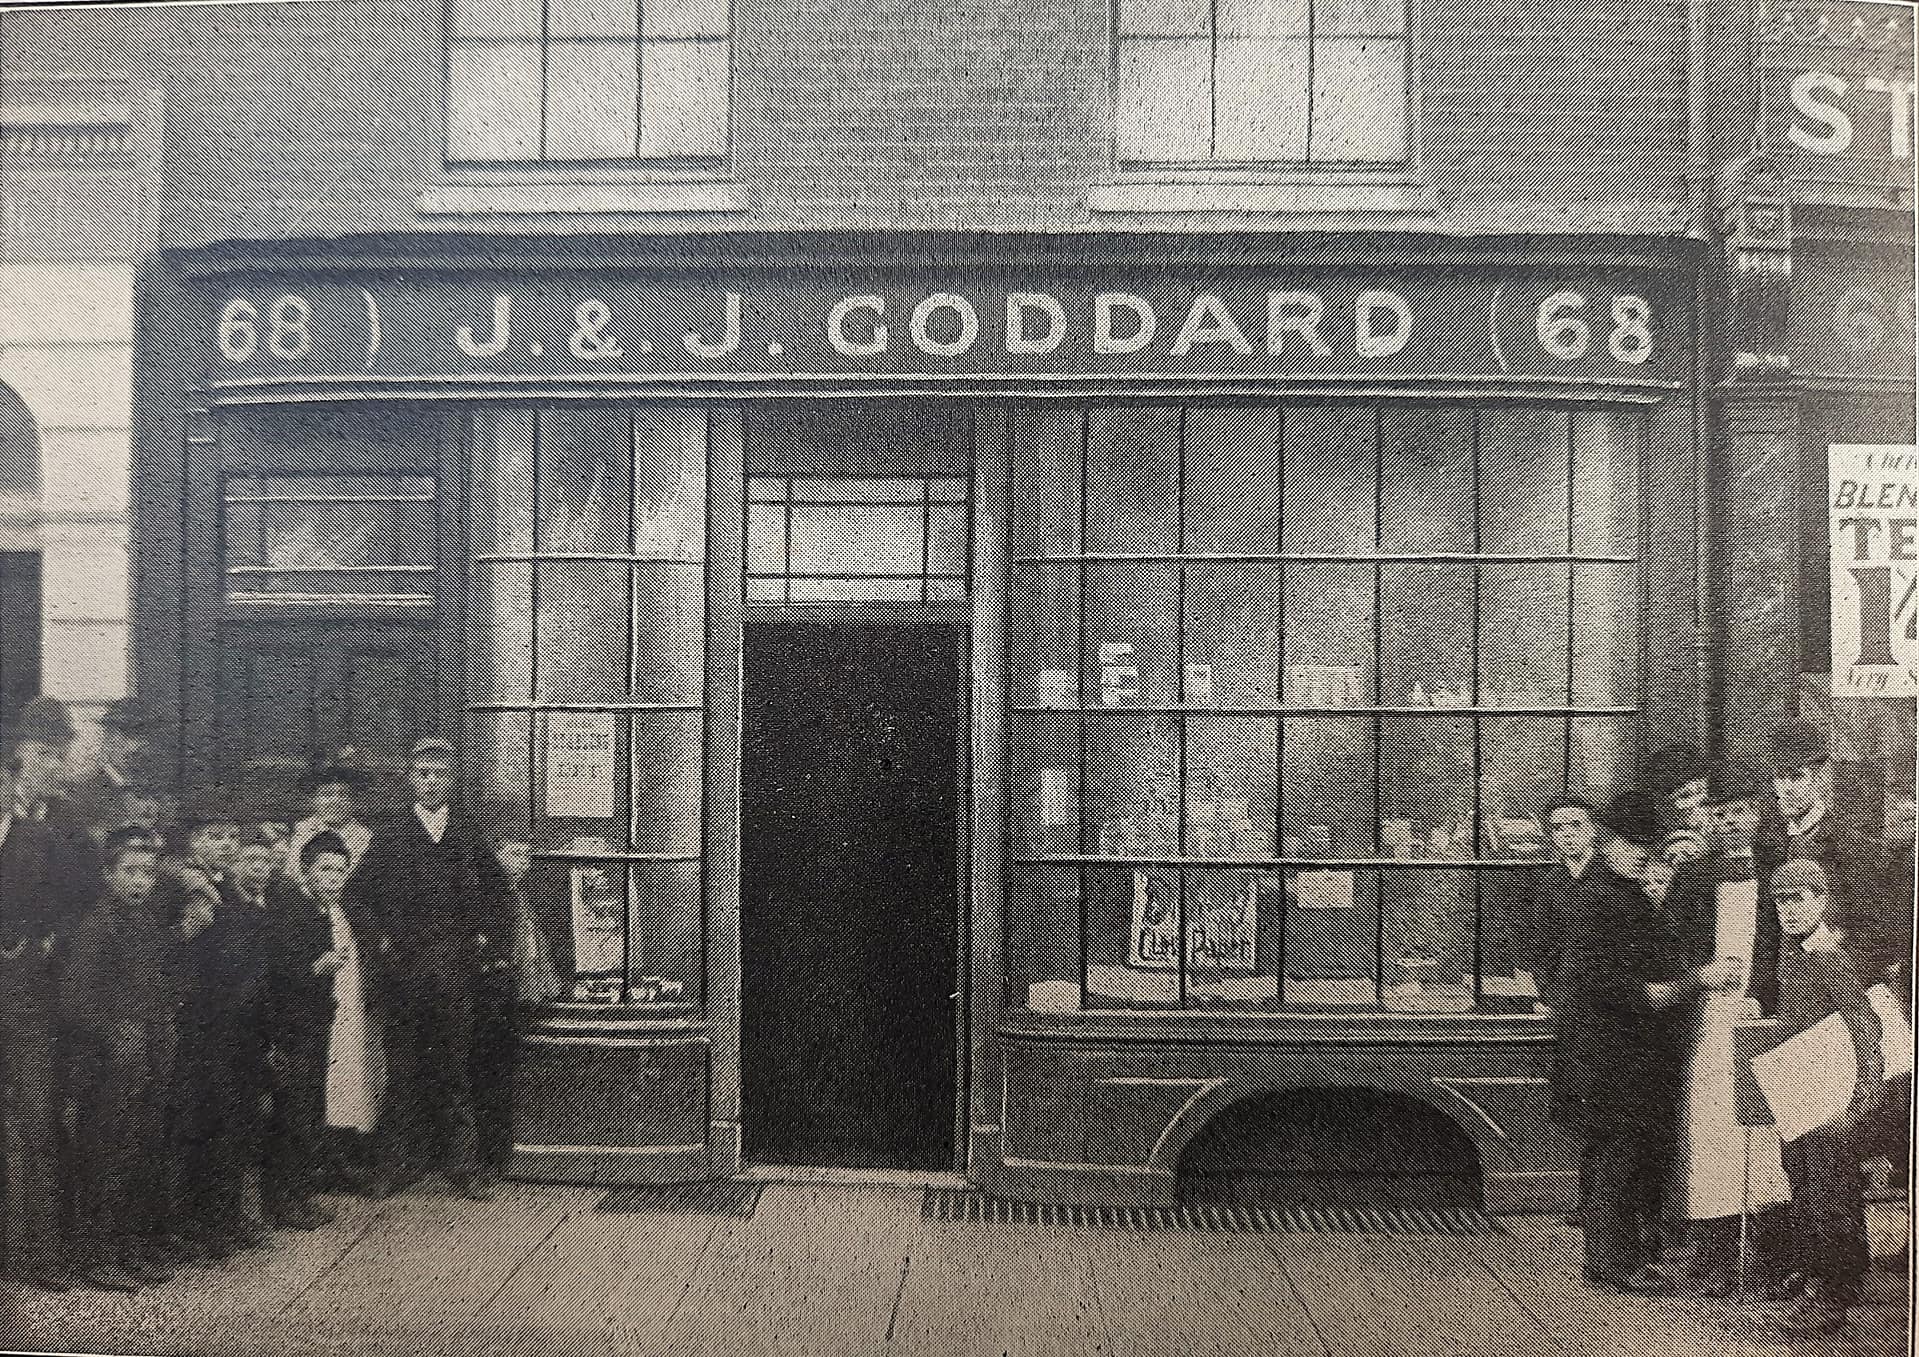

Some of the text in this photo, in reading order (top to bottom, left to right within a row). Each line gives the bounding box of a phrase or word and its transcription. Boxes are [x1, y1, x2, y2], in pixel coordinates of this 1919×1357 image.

[1787, 70, 1915, 158] ST
[217, 296, 313, 363] 68
[827, 291, 1413, 357] GODDARD
[1536, 290, 1654, 364] 68
[1833, 479, 1917, 510] BLEN
[1838, 517, 1917, 561] TE
